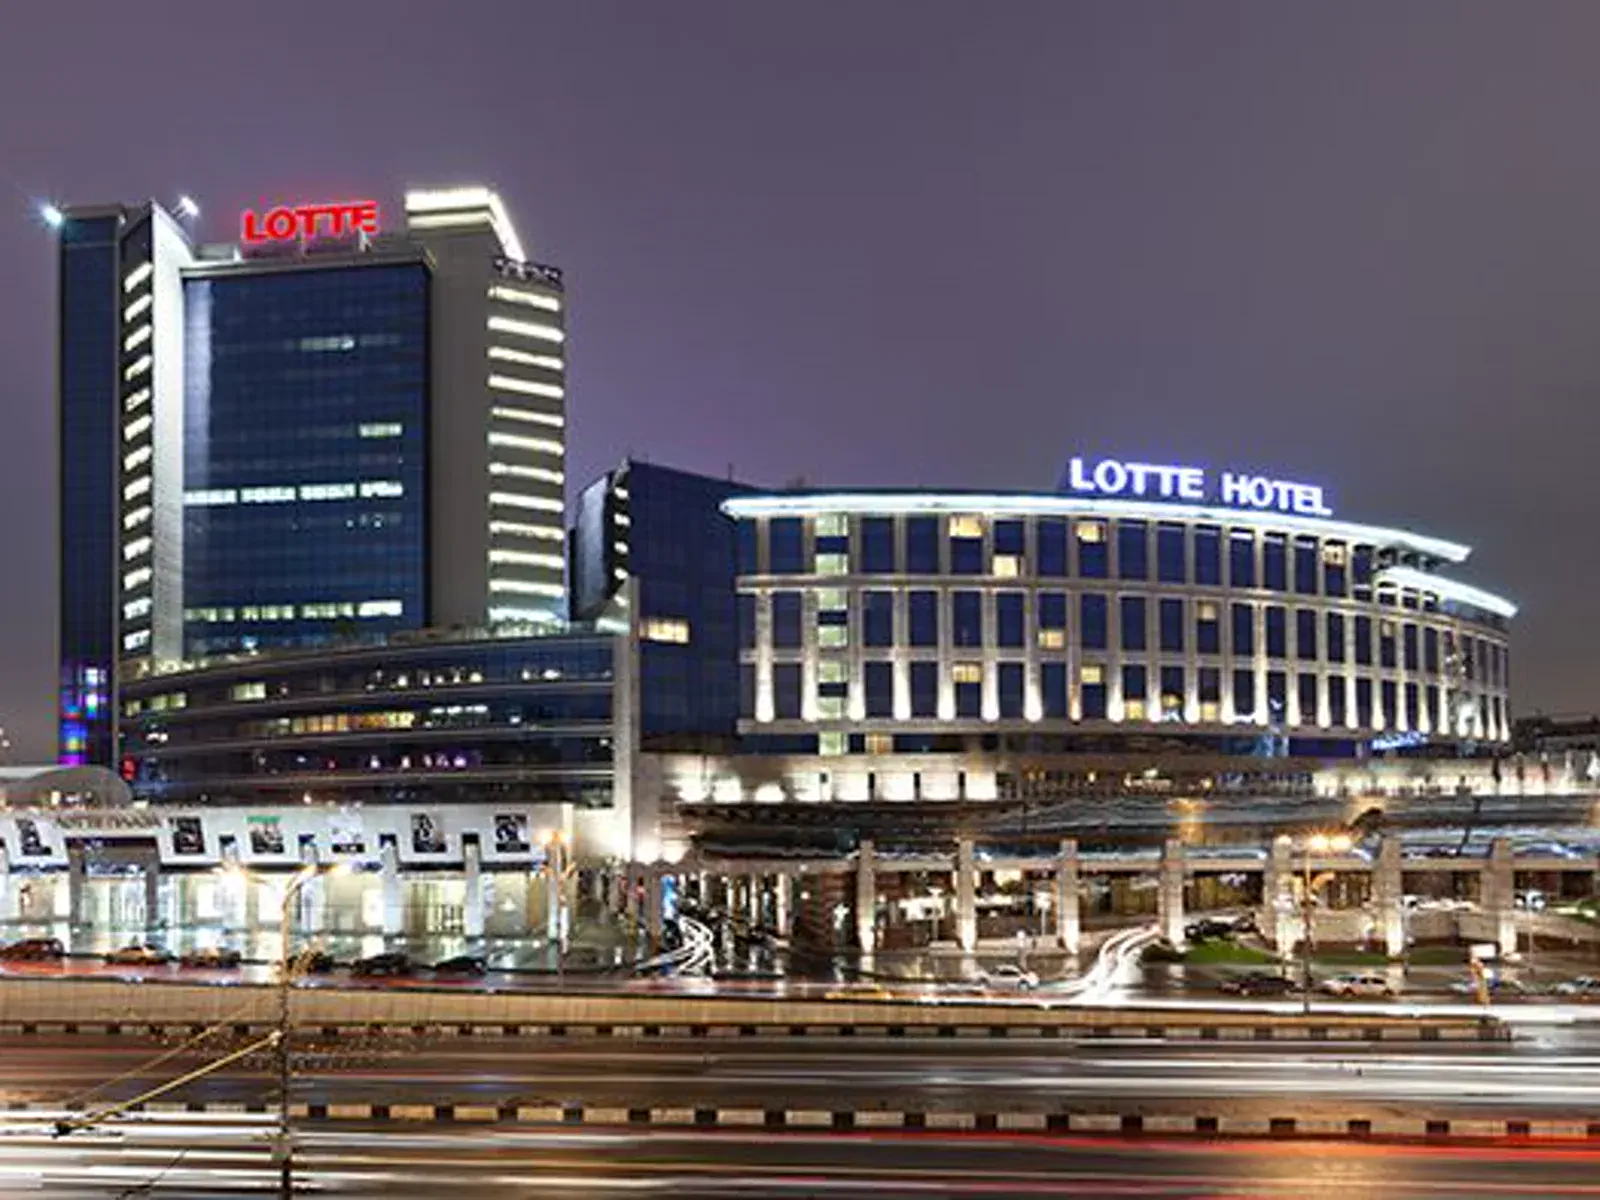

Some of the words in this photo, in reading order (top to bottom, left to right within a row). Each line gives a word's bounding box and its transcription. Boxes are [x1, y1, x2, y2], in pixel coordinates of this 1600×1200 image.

[241, 200, 377, 242] LOTTE
[1069, 457, 1204, 498] LOTTE
[1221, 472, 1333, 516] HOTEL
